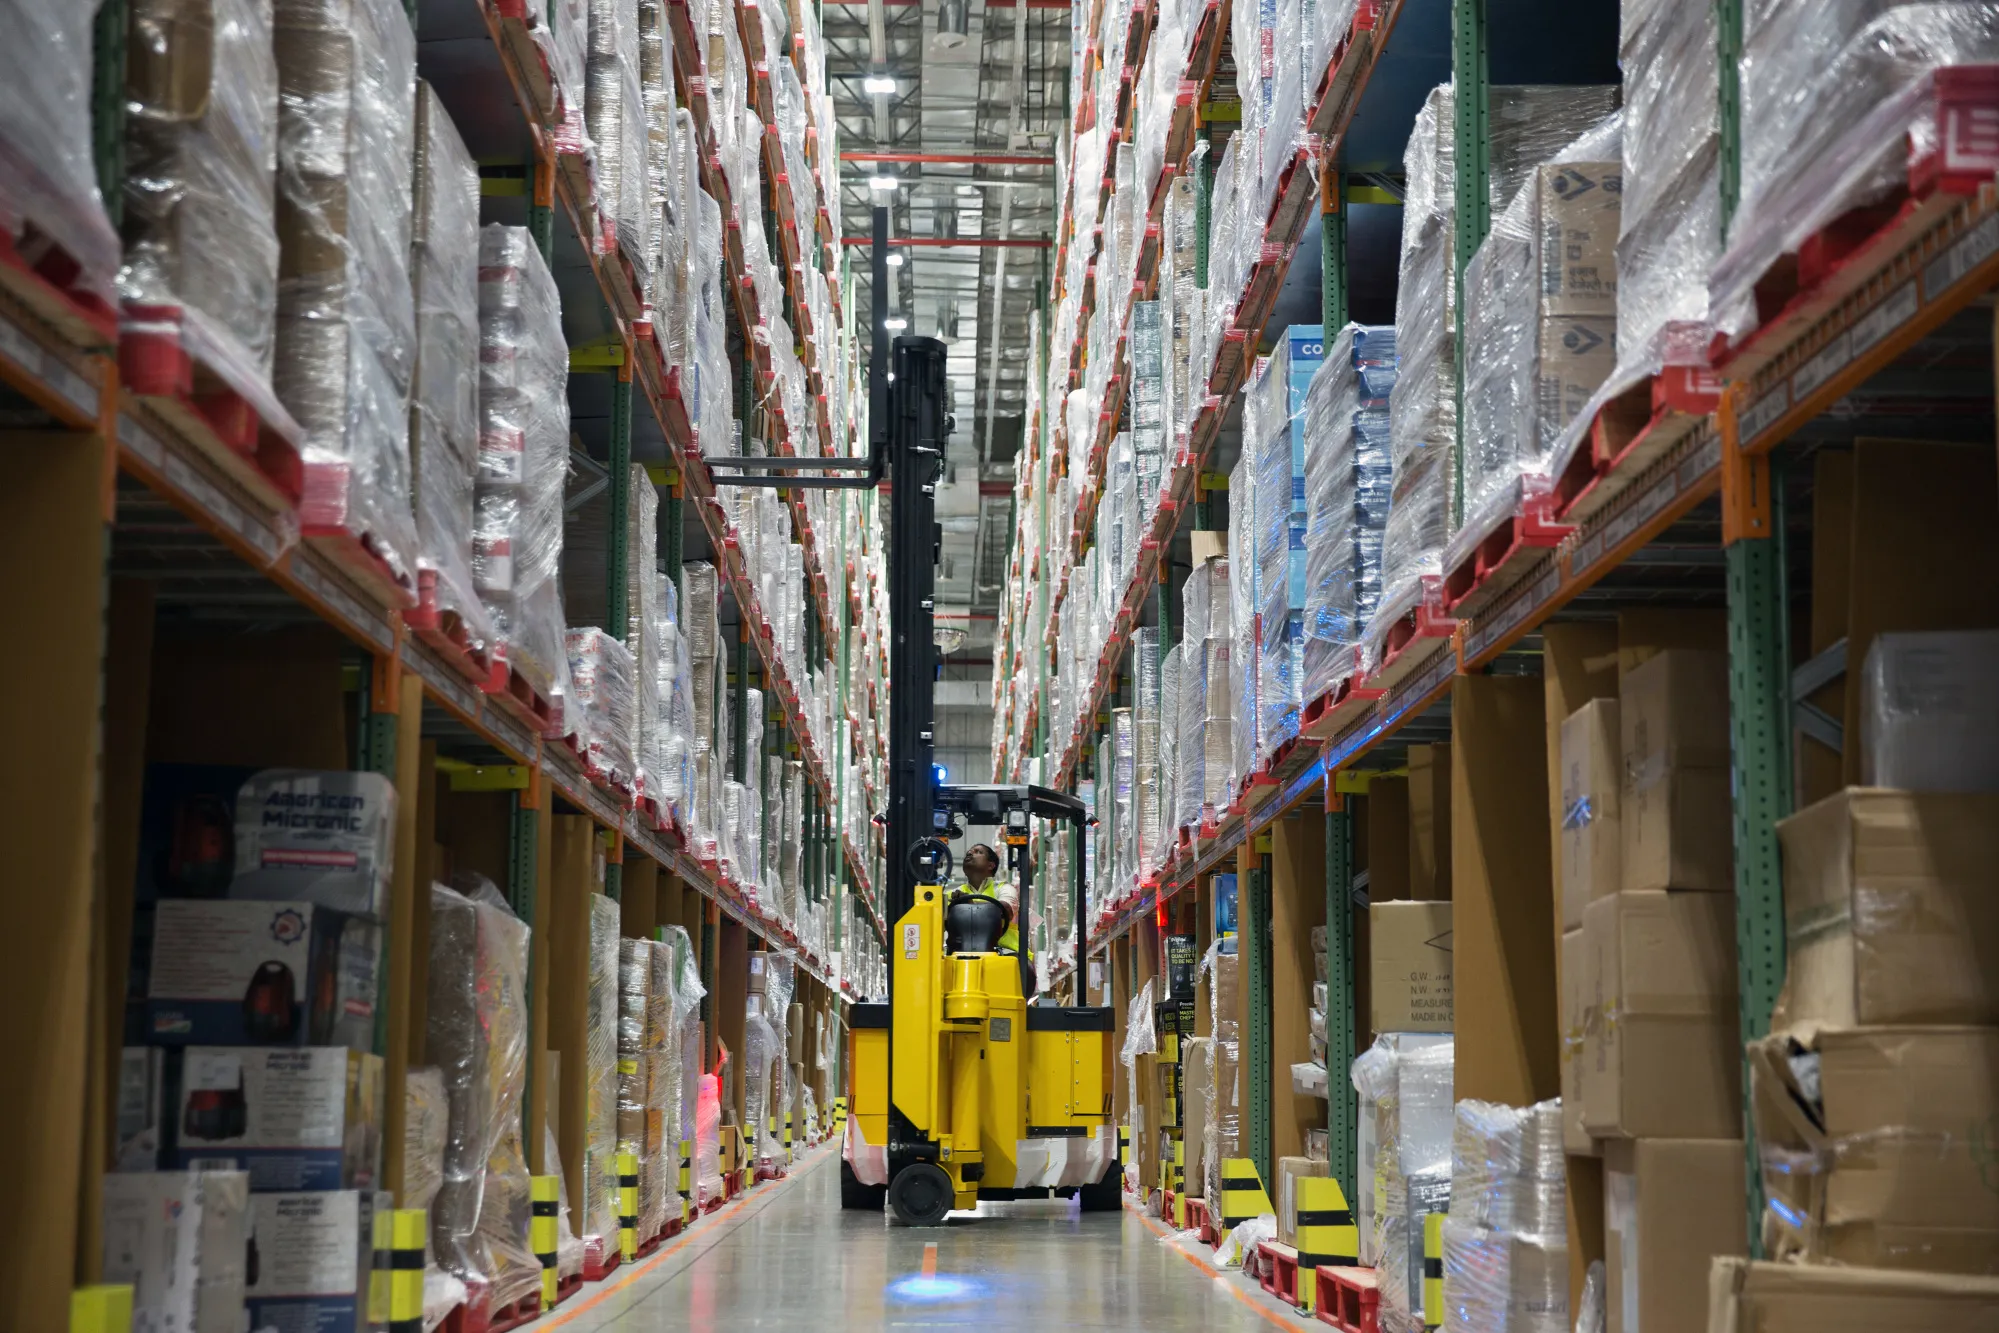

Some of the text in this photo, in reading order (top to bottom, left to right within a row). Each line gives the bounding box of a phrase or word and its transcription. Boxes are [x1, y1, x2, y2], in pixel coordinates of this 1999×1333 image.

[1302, 344, 1323, 355] CO
[265, 791, 364, 810] American
[262, 808, 362, 831] Micronic
[1411, 1013, 1436, 1021] MADE
[1438, 1013, 1447, 1021] IN
